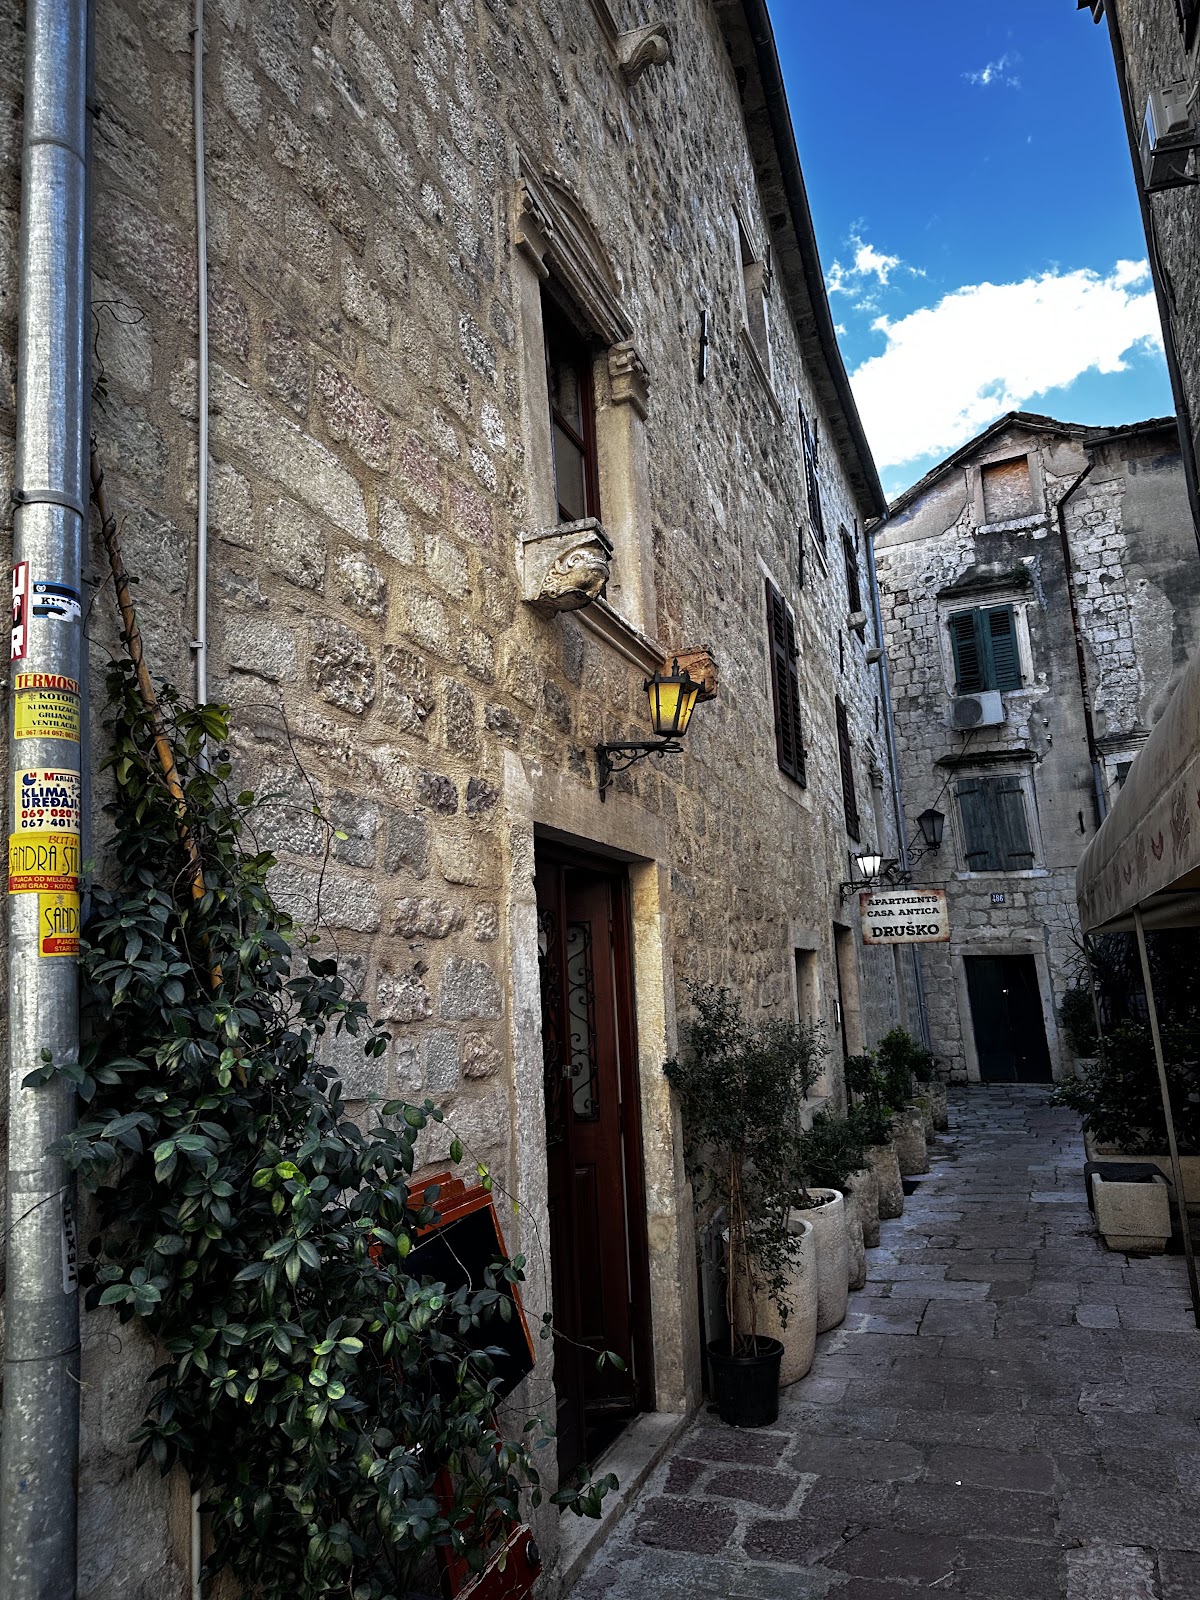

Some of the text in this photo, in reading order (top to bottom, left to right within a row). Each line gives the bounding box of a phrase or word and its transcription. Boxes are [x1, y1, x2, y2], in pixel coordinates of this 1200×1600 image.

[39, 693, 74, 703] KOTOR
[22, 787, 68, 798] KLIMA
[22, 798, 77, 809] UREĐAJI
[21, 809, 44, 818] 069
[51, 809, 72, 817] 020
[21, 819, 44, 828] 067
[50, 819, 71, 827] 401
[10, 846, 56, 876] SANDRA
[867, 896, 938, 906] APARTMENTS
[898, 908, 940, 916] ANTICA
[44, 907, 80, 938] SAND
[871, 921, 940, 938] DRUŠKO
